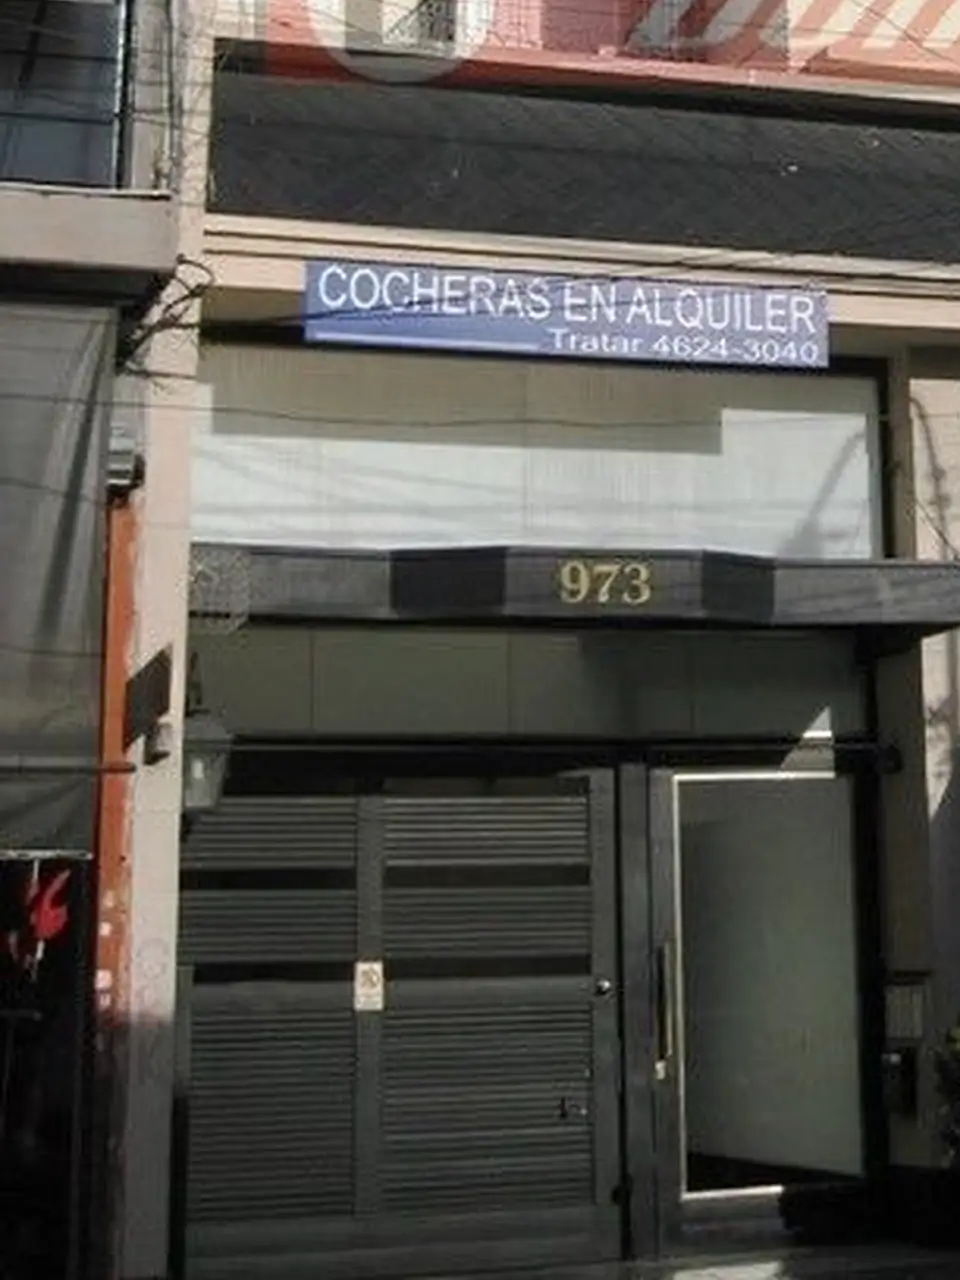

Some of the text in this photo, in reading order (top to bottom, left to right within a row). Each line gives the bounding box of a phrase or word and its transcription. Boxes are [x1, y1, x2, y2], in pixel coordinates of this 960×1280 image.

[318, 264, 818, 334] COCHERAS EN ALQUILER
[548, 326, 820, 363] Tratar 4624-3040
[560, 560, 651, 606] 973
